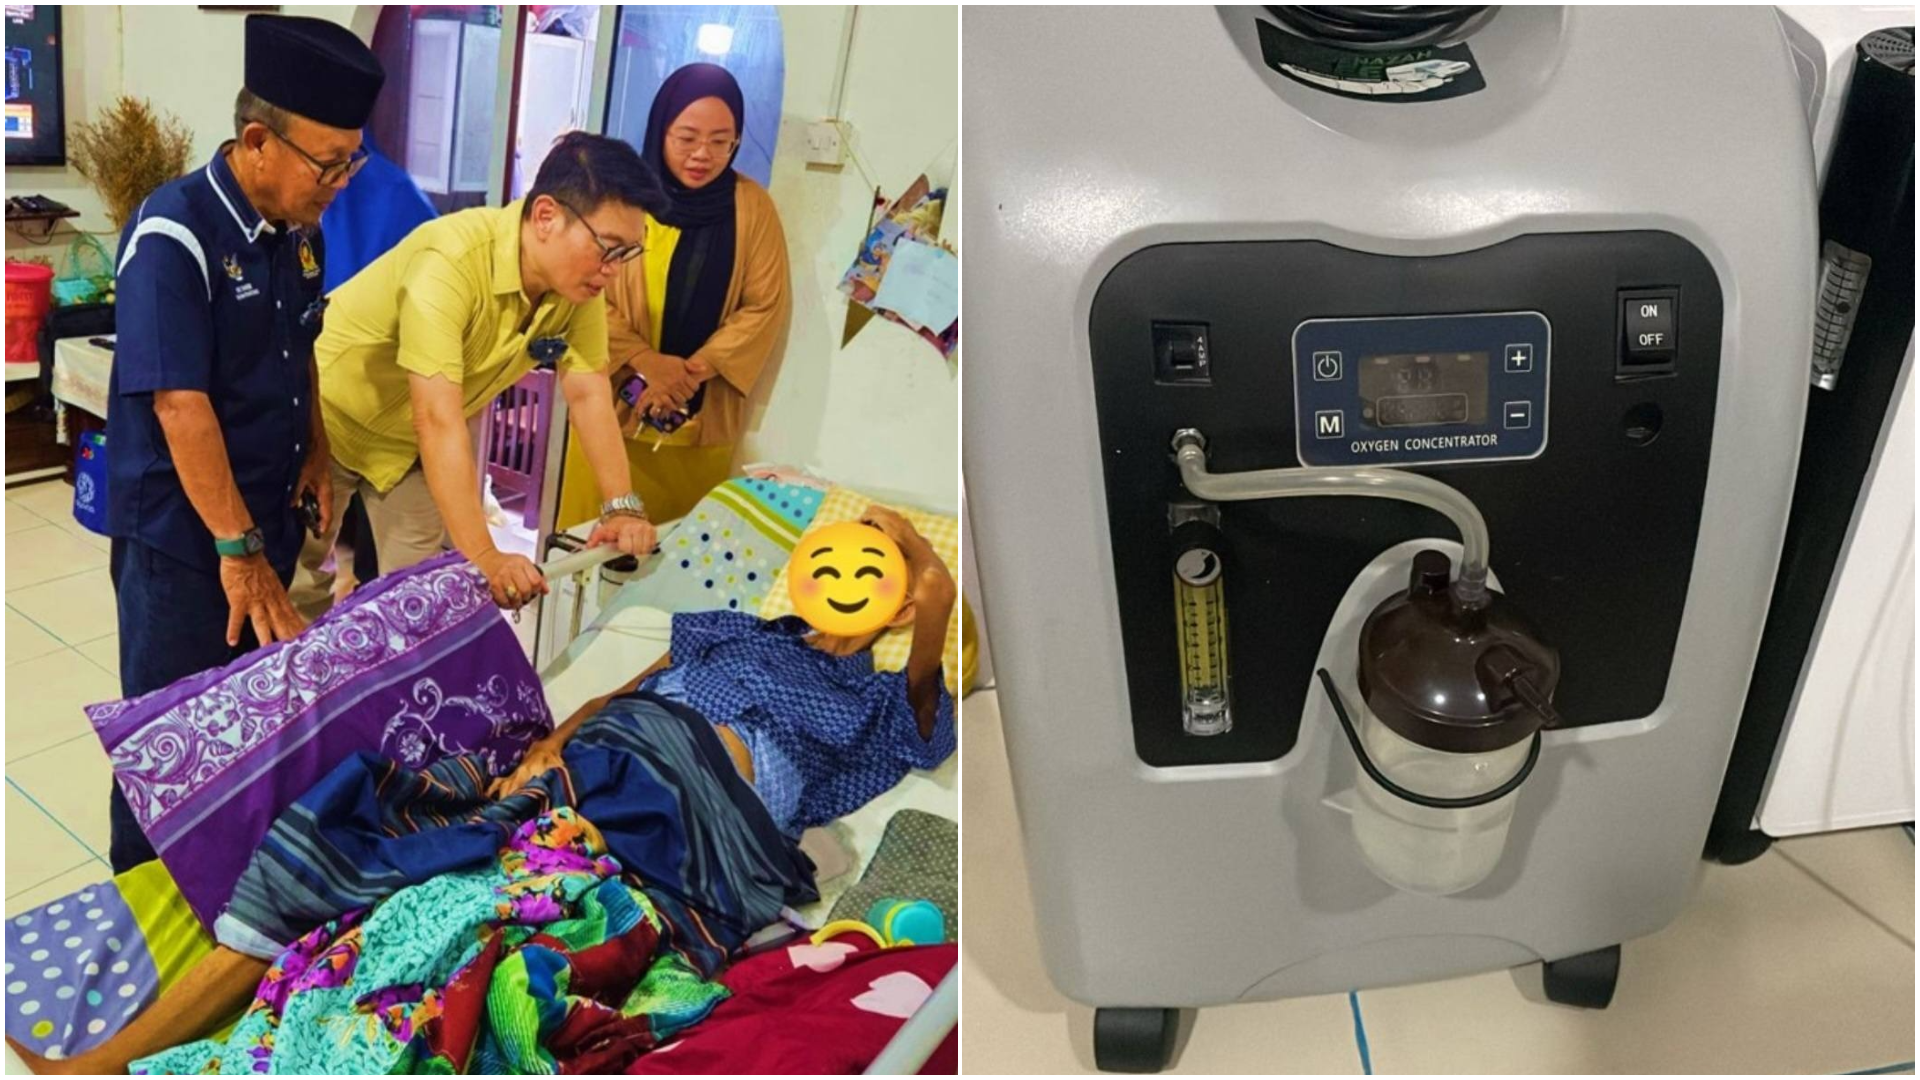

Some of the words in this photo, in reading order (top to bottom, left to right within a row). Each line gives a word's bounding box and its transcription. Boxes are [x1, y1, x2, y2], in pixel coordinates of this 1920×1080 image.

[1640, 304, 1658, 318] ON
[1639, 333, 1663, 346] OFF
[1320, 417, 1340, 433] M
[1351, 440, 1399, 452] OXYGEN
[1405, 434, 1498, 450] CONCENTRATOR
